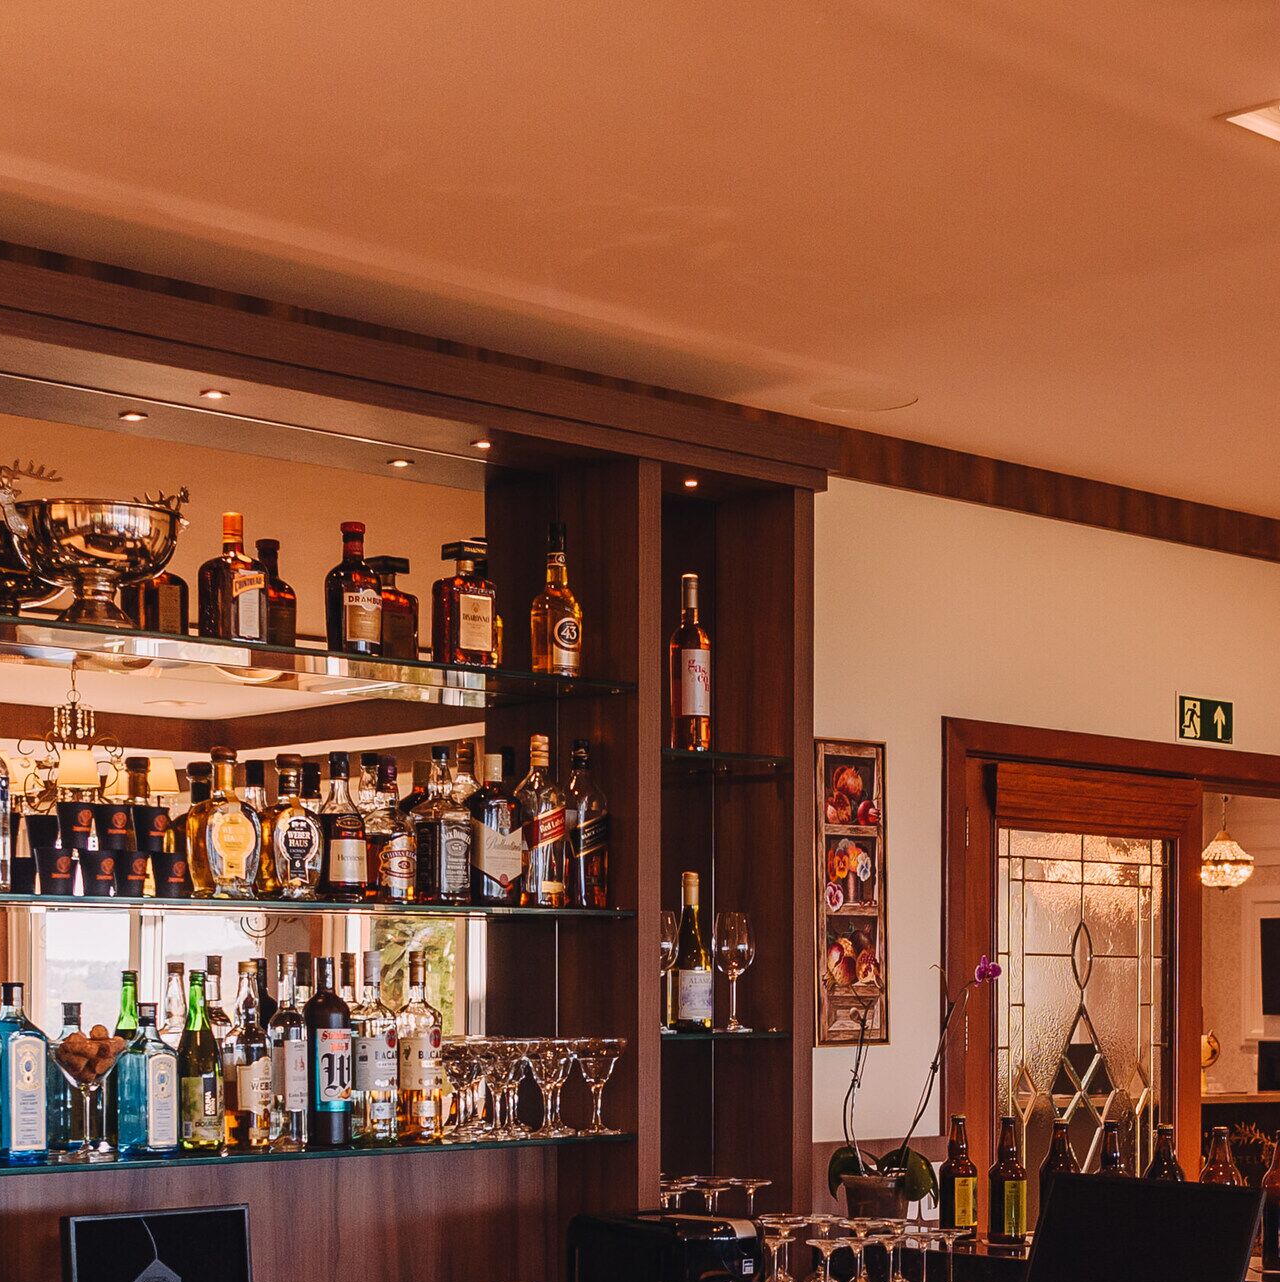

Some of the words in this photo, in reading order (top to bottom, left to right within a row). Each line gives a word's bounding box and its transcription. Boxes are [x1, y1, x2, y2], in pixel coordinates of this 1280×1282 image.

[561, 625, 577, 639] 43
[287, 831, 311, 840] WEBER
[288, 839, 310, 848] HAUS
